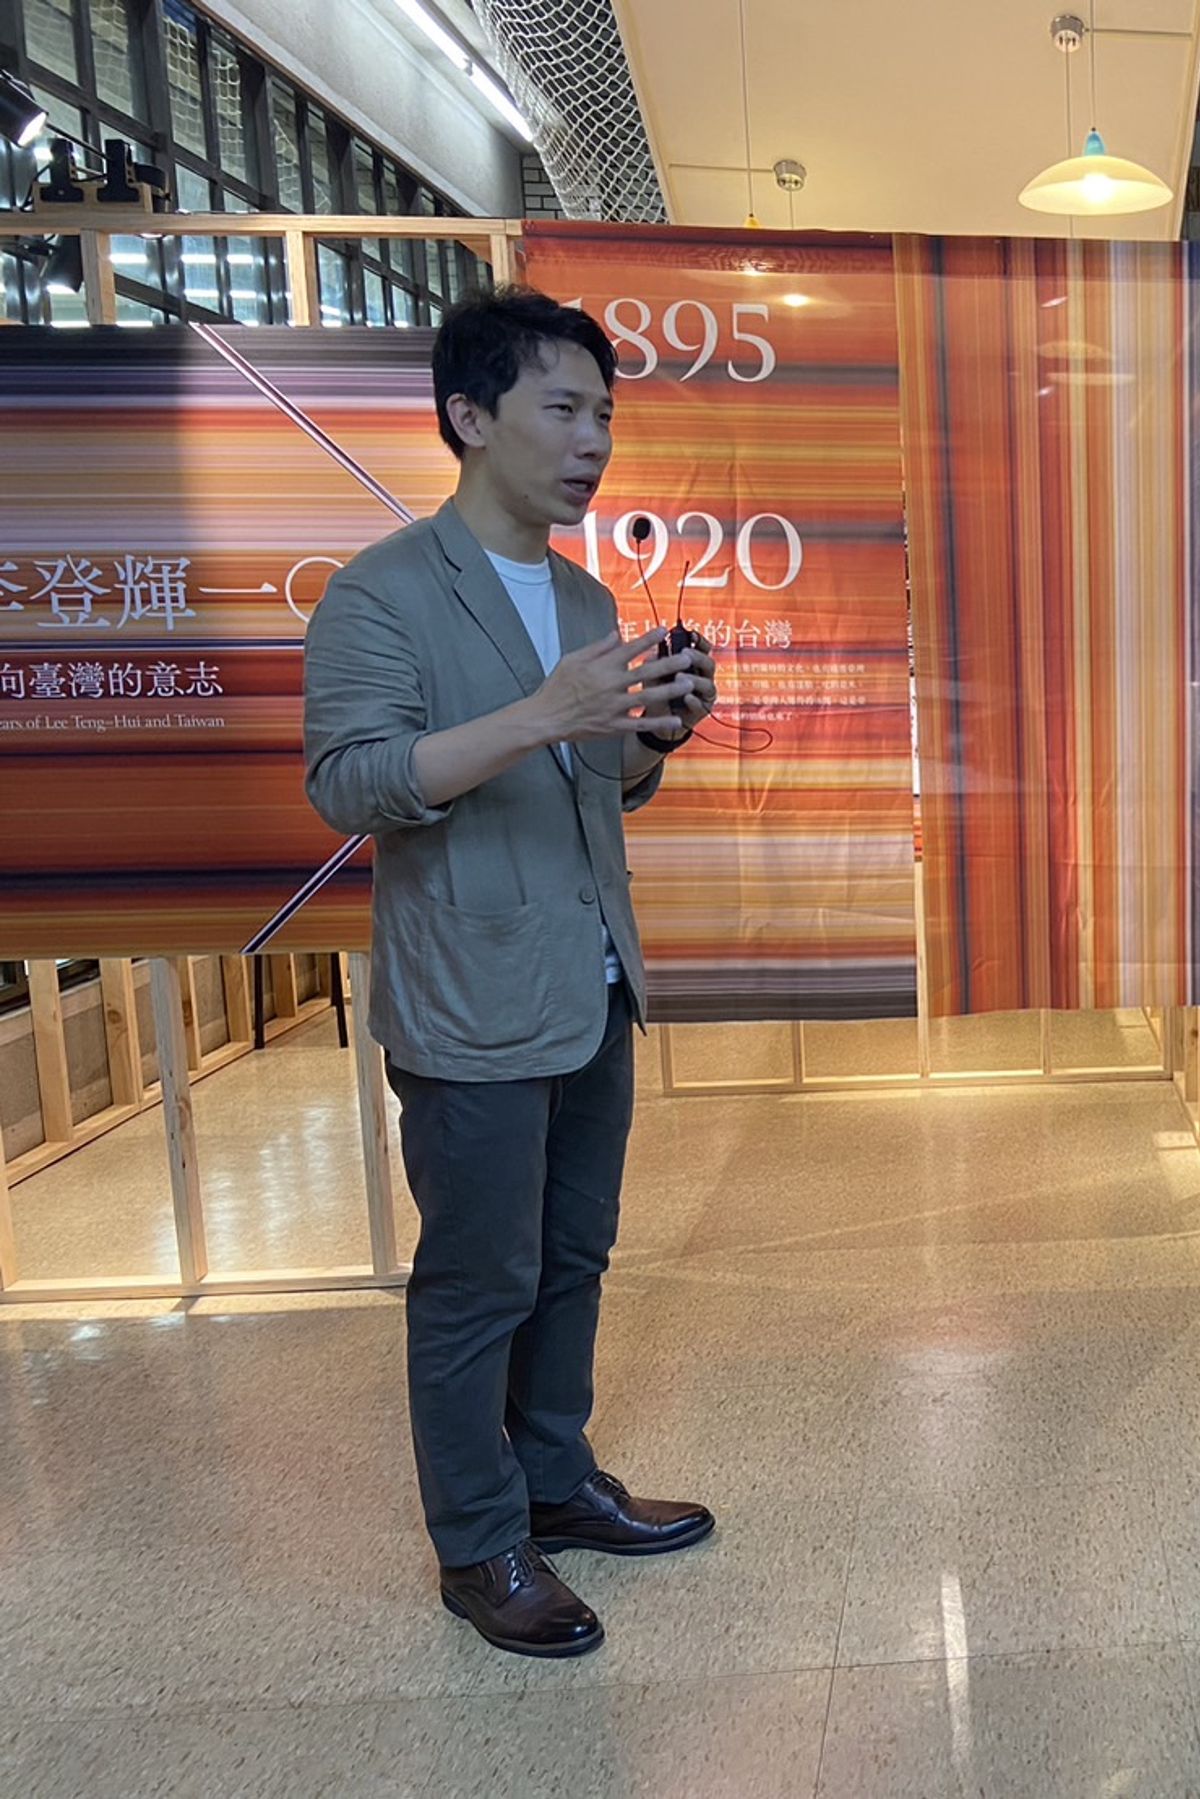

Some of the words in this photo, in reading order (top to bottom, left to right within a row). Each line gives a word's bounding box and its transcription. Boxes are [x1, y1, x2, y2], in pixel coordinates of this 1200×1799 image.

[560, 297, 776, 382] 895
[584, 509, 803, 590] 1920
[0, 661, 224, 698] 向臺灣的意志
[25, 714, 42, 729] of
[45, 715, 69, 729] Lee
[145, 714, 171, 728] and
[174, 713, 225, 728] Taiwan
